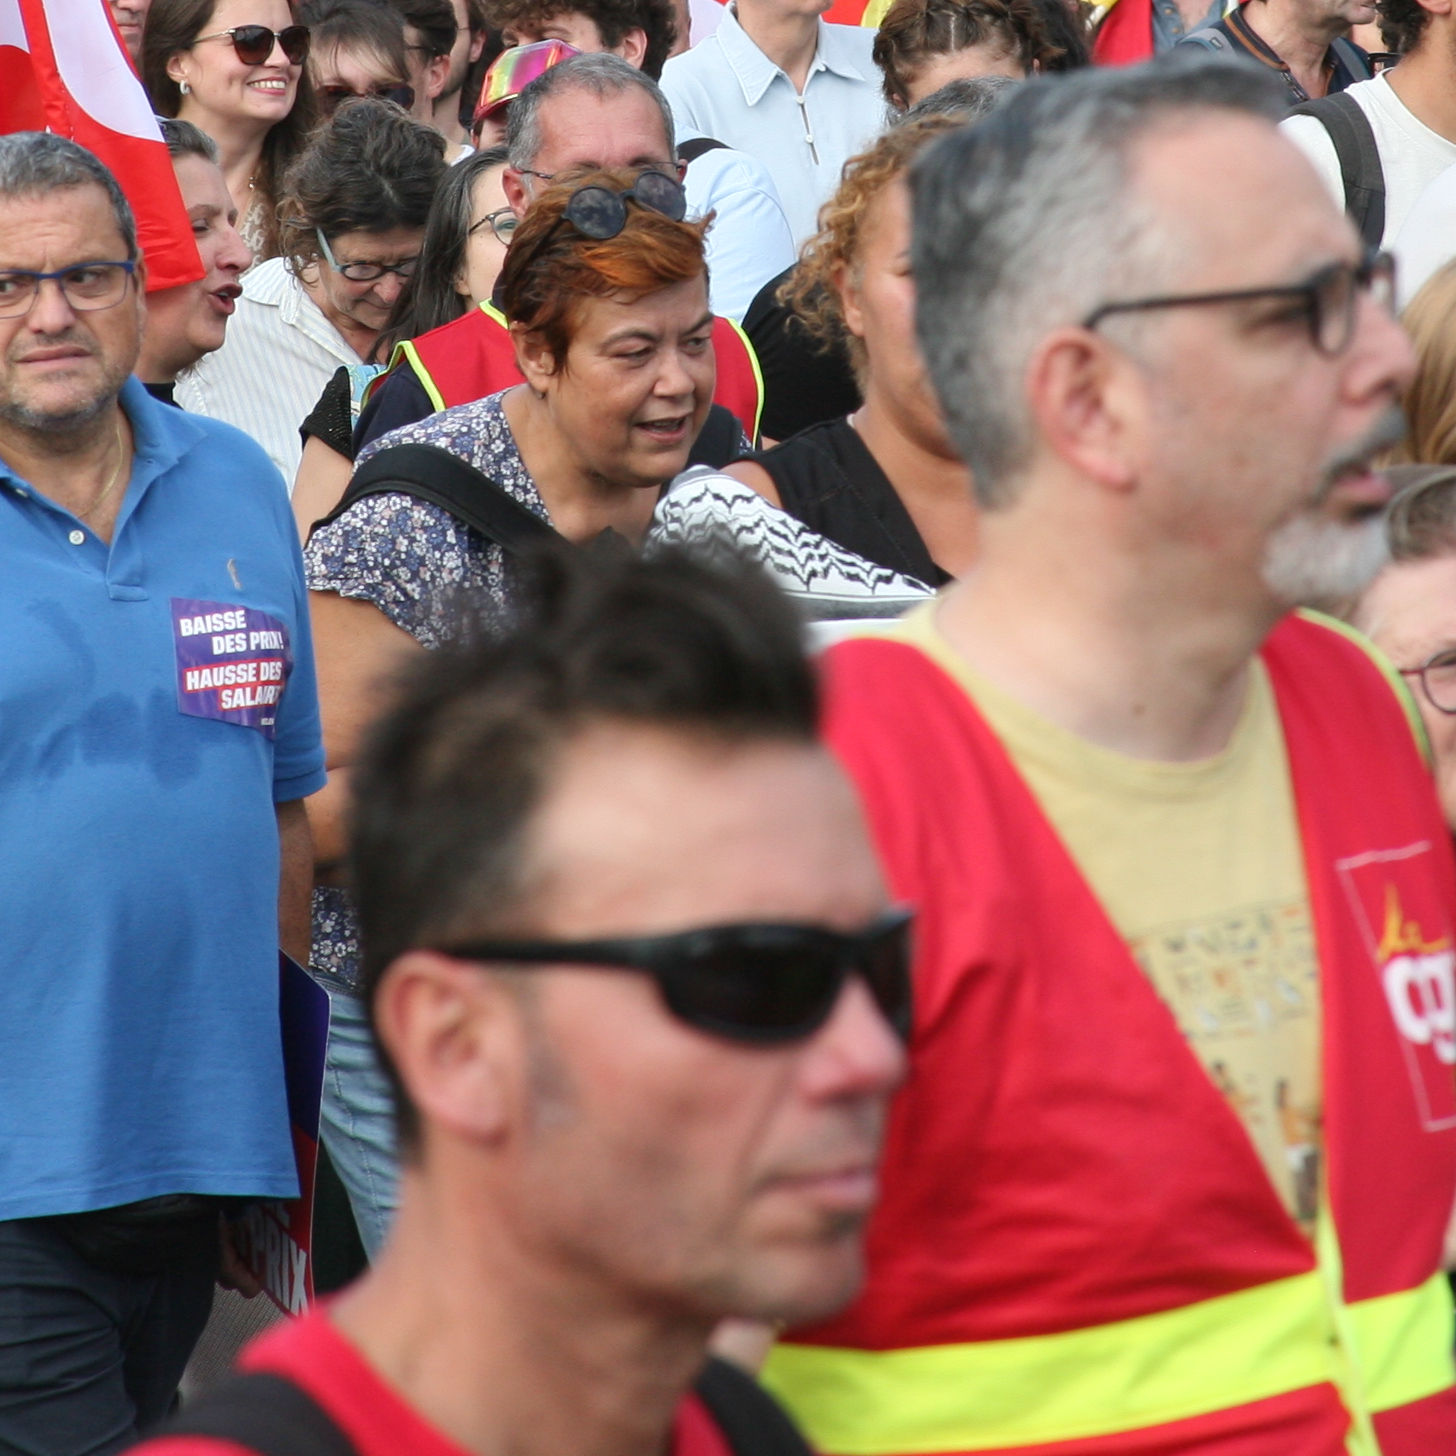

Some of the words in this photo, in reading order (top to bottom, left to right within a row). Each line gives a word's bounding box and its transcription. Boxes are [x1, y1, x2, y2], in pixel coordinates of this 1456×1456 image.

[179, 609, 247, 637] BAISSE
[211, 632, 247, 656] DES
[249, 630, 284, 651] PRIX!
[185, 662, 257, 691] HAUSSE
[260, 661, 283, 682] DES
